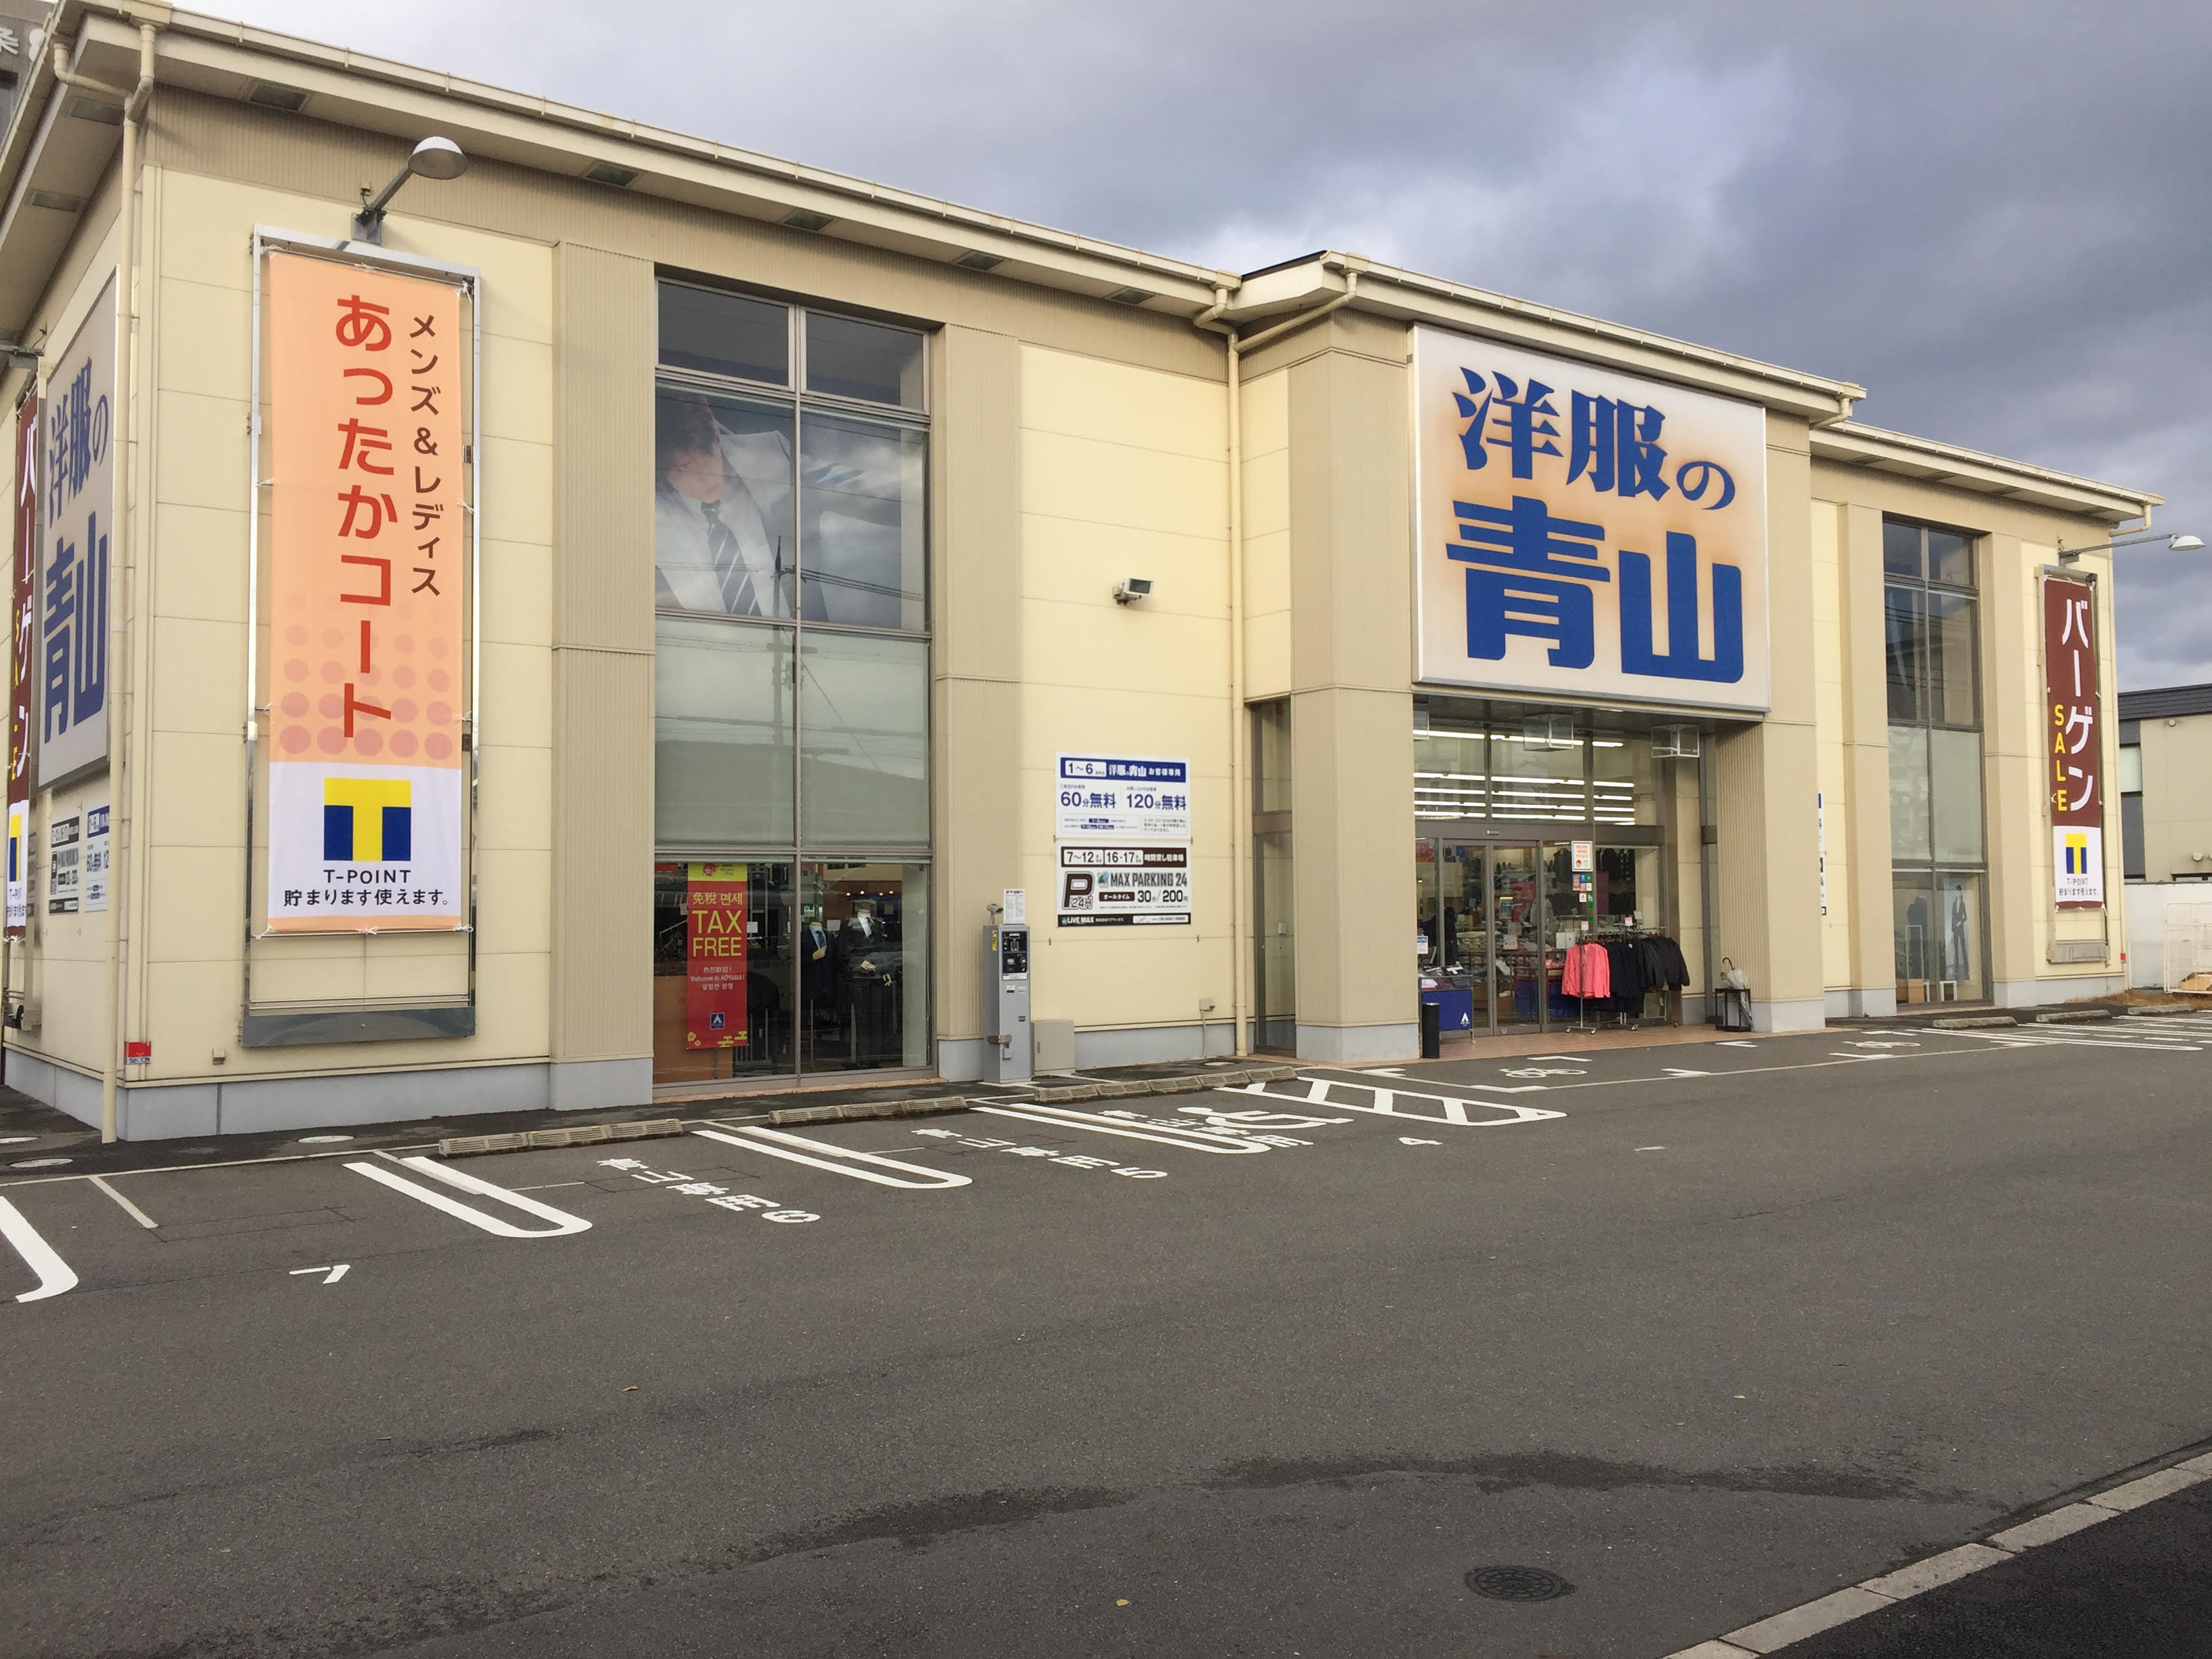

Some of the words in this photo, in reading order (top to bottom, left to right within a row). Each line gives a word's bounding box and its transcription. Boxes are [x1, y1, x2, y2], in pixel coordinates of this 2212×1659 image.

[49, 356, 108, 529] 洋服の
[1452, 366, 1736, 510] 洋服の
[409, 314, 443, 596] メンズ&レディス
[335, 294, 398, 738] あったかコート
[1446, 495, 1744, 684] 青山
[44, 511, 107, 744] 青山
[2062, 598, 2093, 811] バーゲン
[2054, 704, 2068, 811] SALE
[1061, 792, 1116, 808] 60分無料
[1126, 794, 1187, 811] 120分無料
[323, 869, 411, 884] T-POINT
[1110, 872, 1130, 887] MAX
[1132, 872, 1173, 887] PARKING
[1176, 872, 1187, 886] 24
[2067, 878, 2088, 886] T-POINT
[283, 888, 450, 907] 貯まります使えます。
[720, 892, 743, 905] 면세
[1071, 897, 1092, 909] 24H
[692, 909, 742, 935] TAX
[693, 937, 742, 957] FREE
[1399, 1136, 1442, 1145] 4
[1111, 1167, 1168, 1179] 5
[761, 1210, 821, 1223] 6
